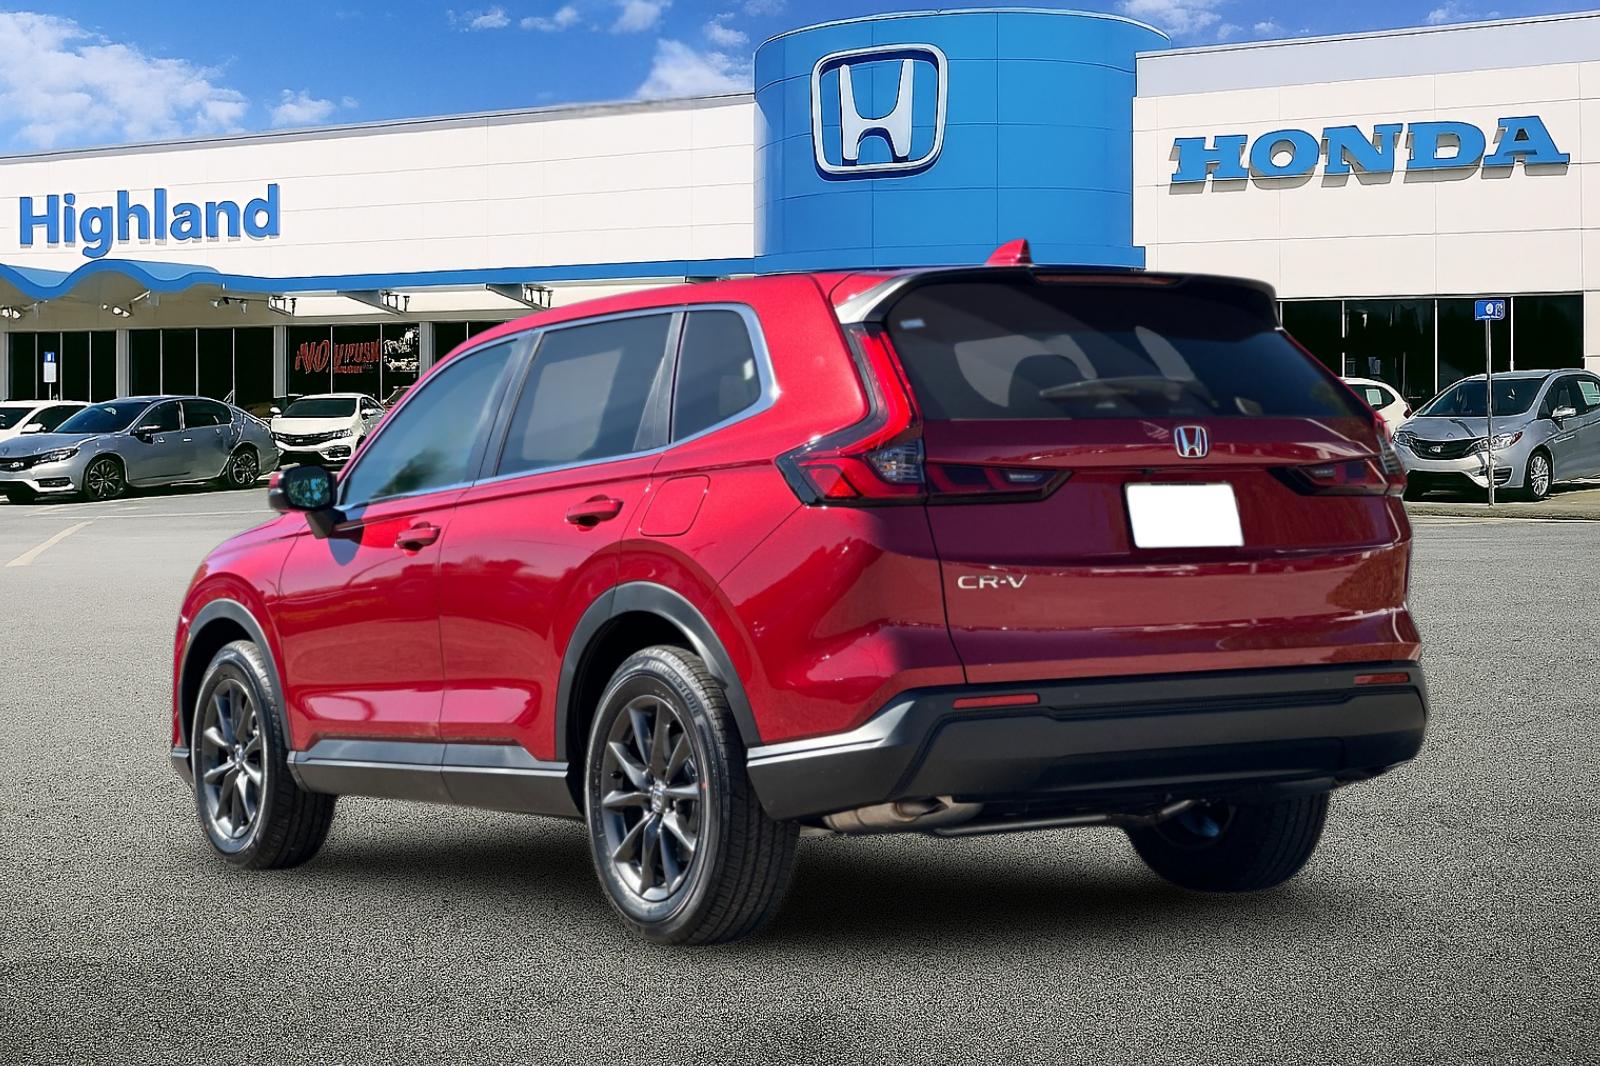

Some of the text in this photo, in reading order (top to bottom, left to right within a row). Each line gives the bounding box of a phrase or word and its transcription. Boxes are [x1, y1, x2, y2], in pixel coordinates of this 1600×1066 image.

[1171, 115, 1570, 183] HONDA
[19, 183, 280, 258] Highland
[957, 575, 1028, 589] CR-V
